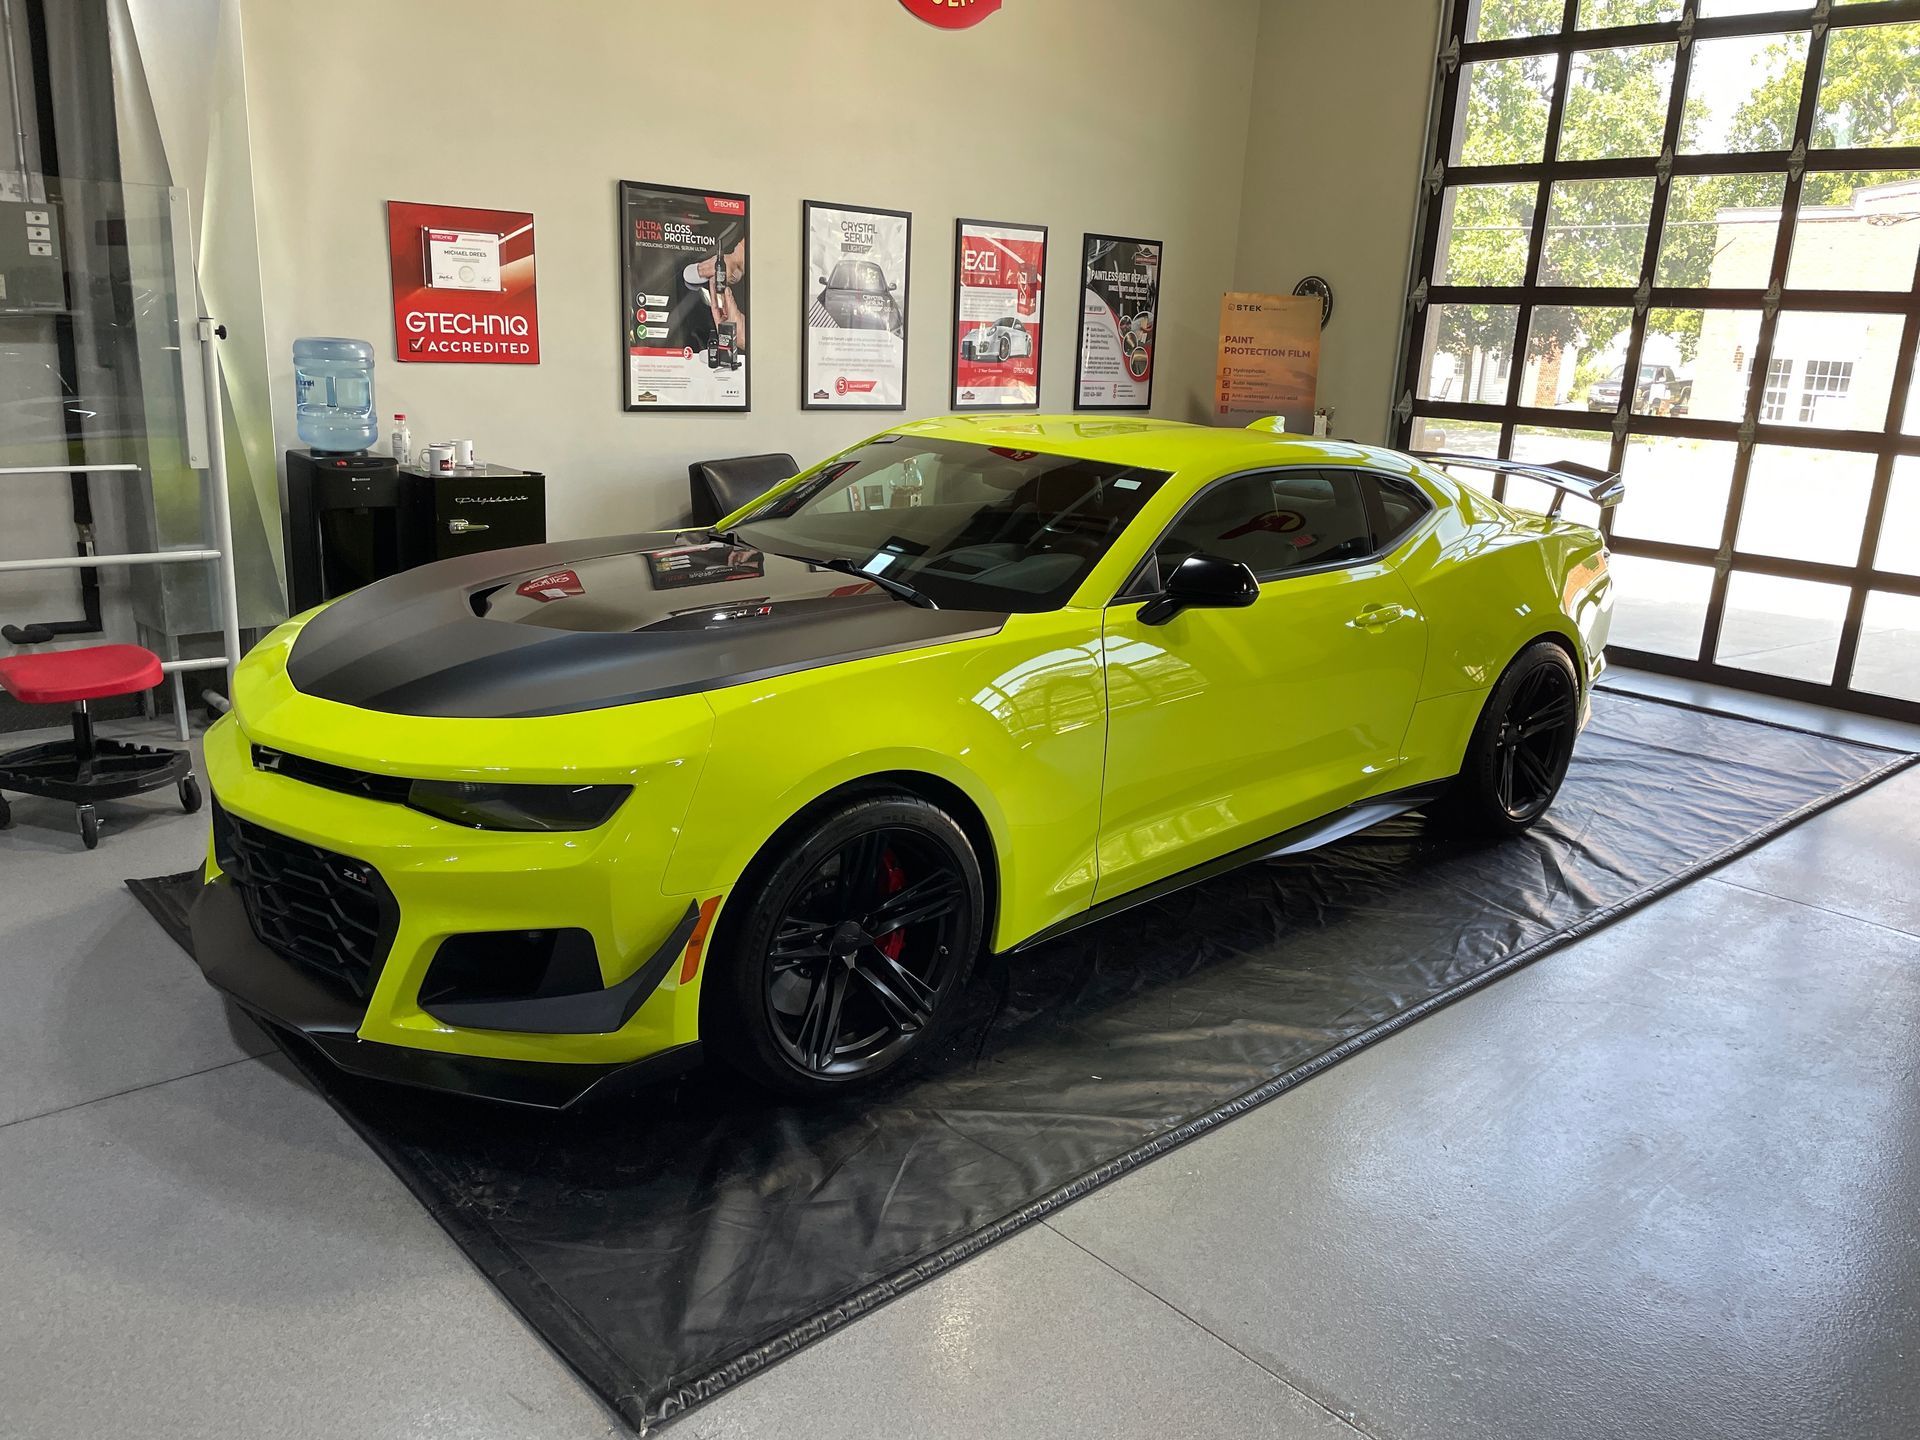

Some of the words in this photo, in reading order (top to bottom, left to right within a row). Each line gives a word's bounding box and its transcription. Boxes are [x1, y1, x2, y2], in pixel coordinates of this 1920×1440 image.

[713, 200, 739, 209] GTECHNIQ
[635, 220, 662, 231] ULTRA
[664, 222, 693, 235] GLOSS,
[840, 221, 878, 234] CRYSTAL
[635, 230, 662, 241] ULTRA
[664, 232, 716, 246] PROTECTION
[844, 233, 874, 244] SERUM
[635, 241, 663, 249] INTRODUCING
[964, 249, 997, 271] EXO
[1091, 269, 1119, 282] PAINTLESS
[1118, 271, 1131, 282] DENT
[1236, 304, 1262, 312] STEK
[405, 311, 528, 336] GTECHNIQ
[1225, 335, 1254, 345] PAINT
[428, 341, 530, 354] ACCREDITED
[1224, 346, 1286, 358] PROTECTION
[1288, 349, 1311, 359] FILM
[343, 868, 368, 884] ZL1
